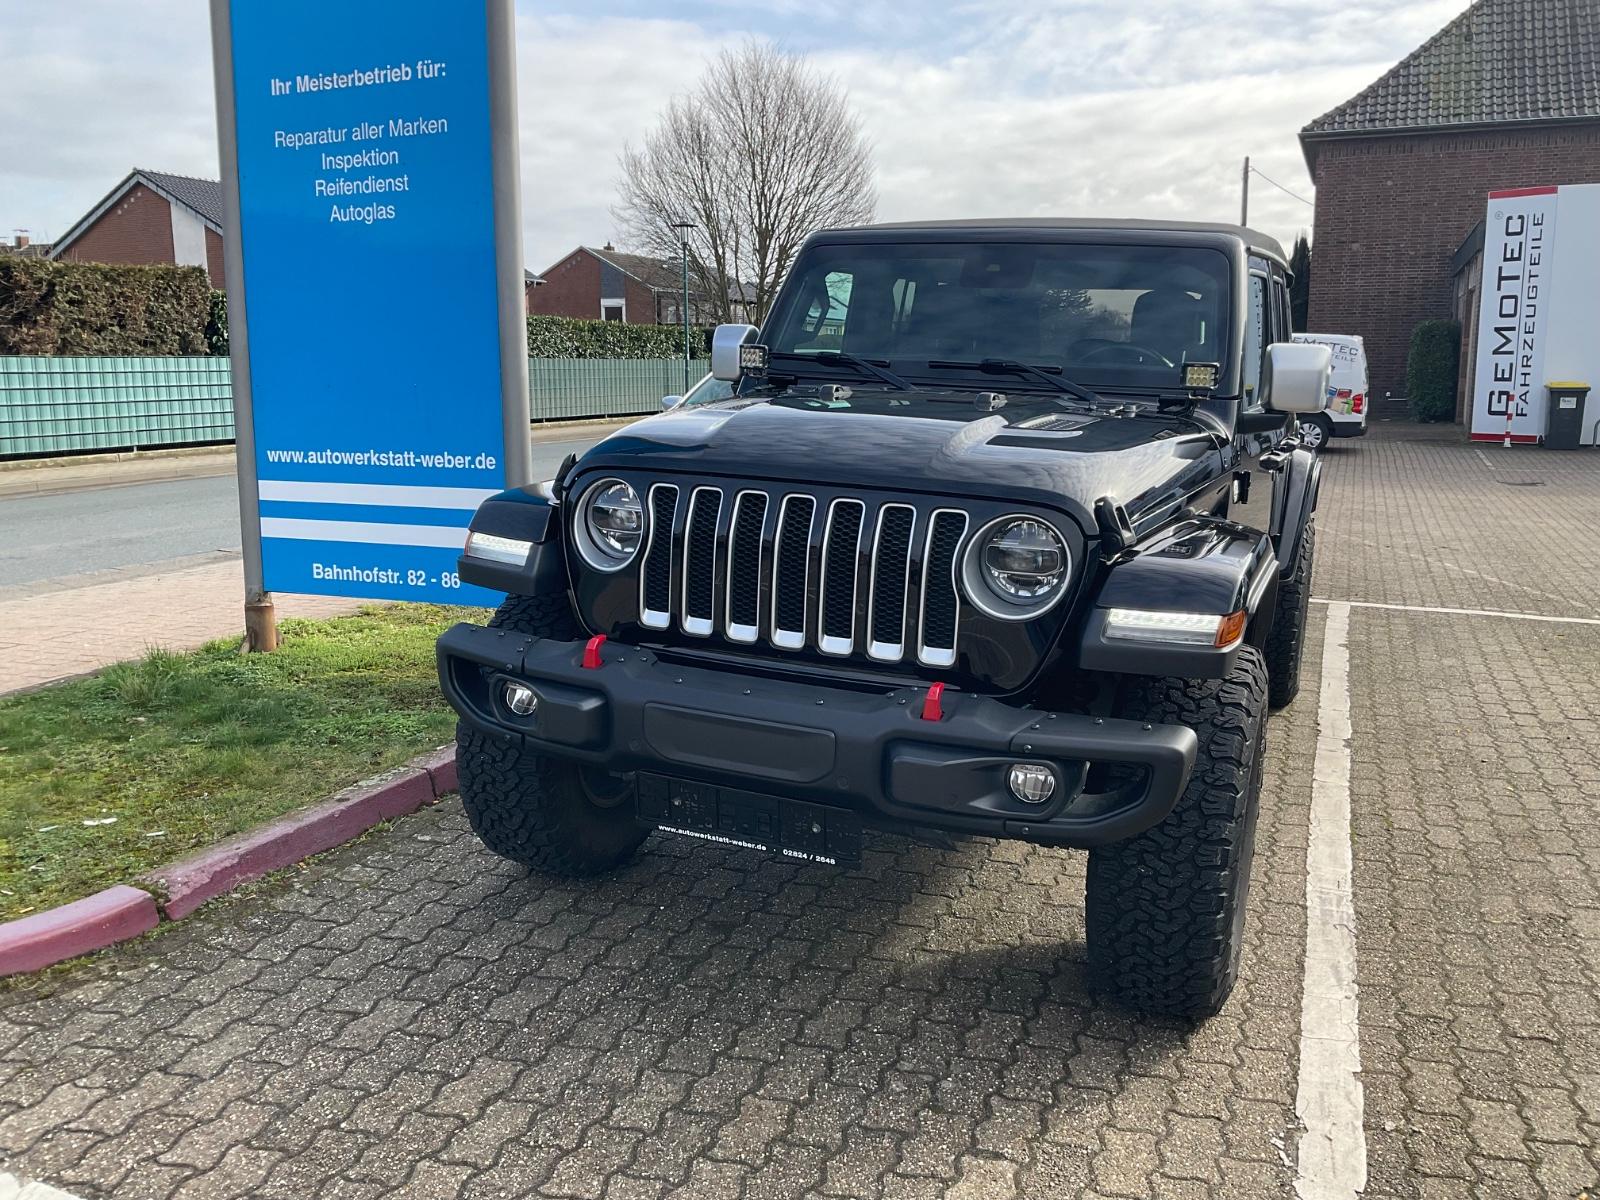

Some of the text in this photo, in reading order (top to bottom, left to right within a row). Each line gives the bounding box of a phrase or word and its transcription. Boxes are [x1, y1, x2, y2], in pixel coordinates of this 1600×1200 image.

[271, 59, 446, 96] Ihr Meisterbetrieb für:
[274, 117, 448, 150] Reparatur aller Marken
[322, 149, 399, 172] Inspektion
[315, 174, 409, 197] Reifendienst
[330, 202, 395, 225] Autoglas
[1486, 212, 1526, 417] GEMOTEC
[1515, 213, 1545, 417] FAHRZEUGTEILE
[267, 448, 496, 470] www.autowerkstatt-weber.de
[312, 563, 403, 585] Bahnhofstr.
[407, 569, 426, 586] 82
[441, 571, 461, 589] 86
[658, 825, 767, 851] www.autowerkstatt-weber.de
